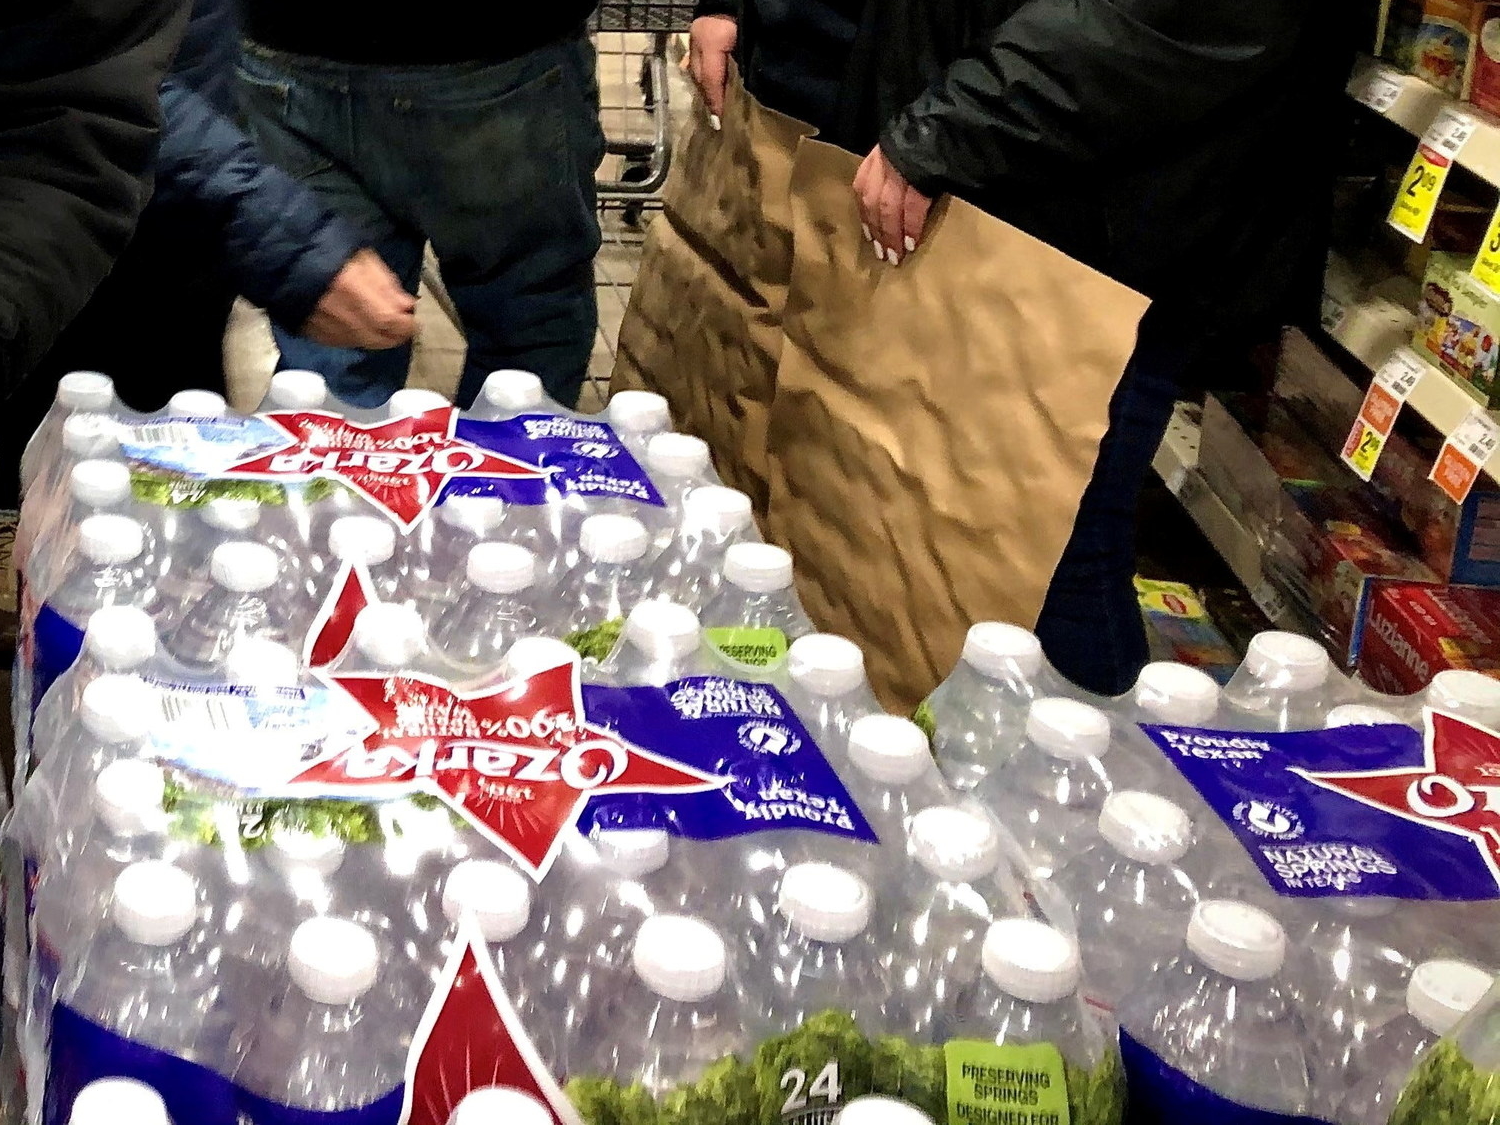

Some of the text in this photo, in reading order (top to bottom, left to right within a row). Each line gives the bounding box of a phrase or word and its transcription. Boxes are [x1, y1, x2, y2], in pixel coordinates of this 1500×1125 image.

[1159, 729, 1272, 753] Proudly
[1170, 742, 1263, 761] Texan
[345, 739, 629, 790] Ozarka
[744, 801, 856, 831] Proudly
[1261, 842, 1384, 866] NATURAL
[1273, 856, 1398, 880] SPRINGS
[780, 1056, 843, 1115] 24
[960, 1061, 1051, 1090] PRESERVING
[973, 1082, 1039, 1106] SPRINGS
[956, 1101, 1030, 1125] DESIGNED
